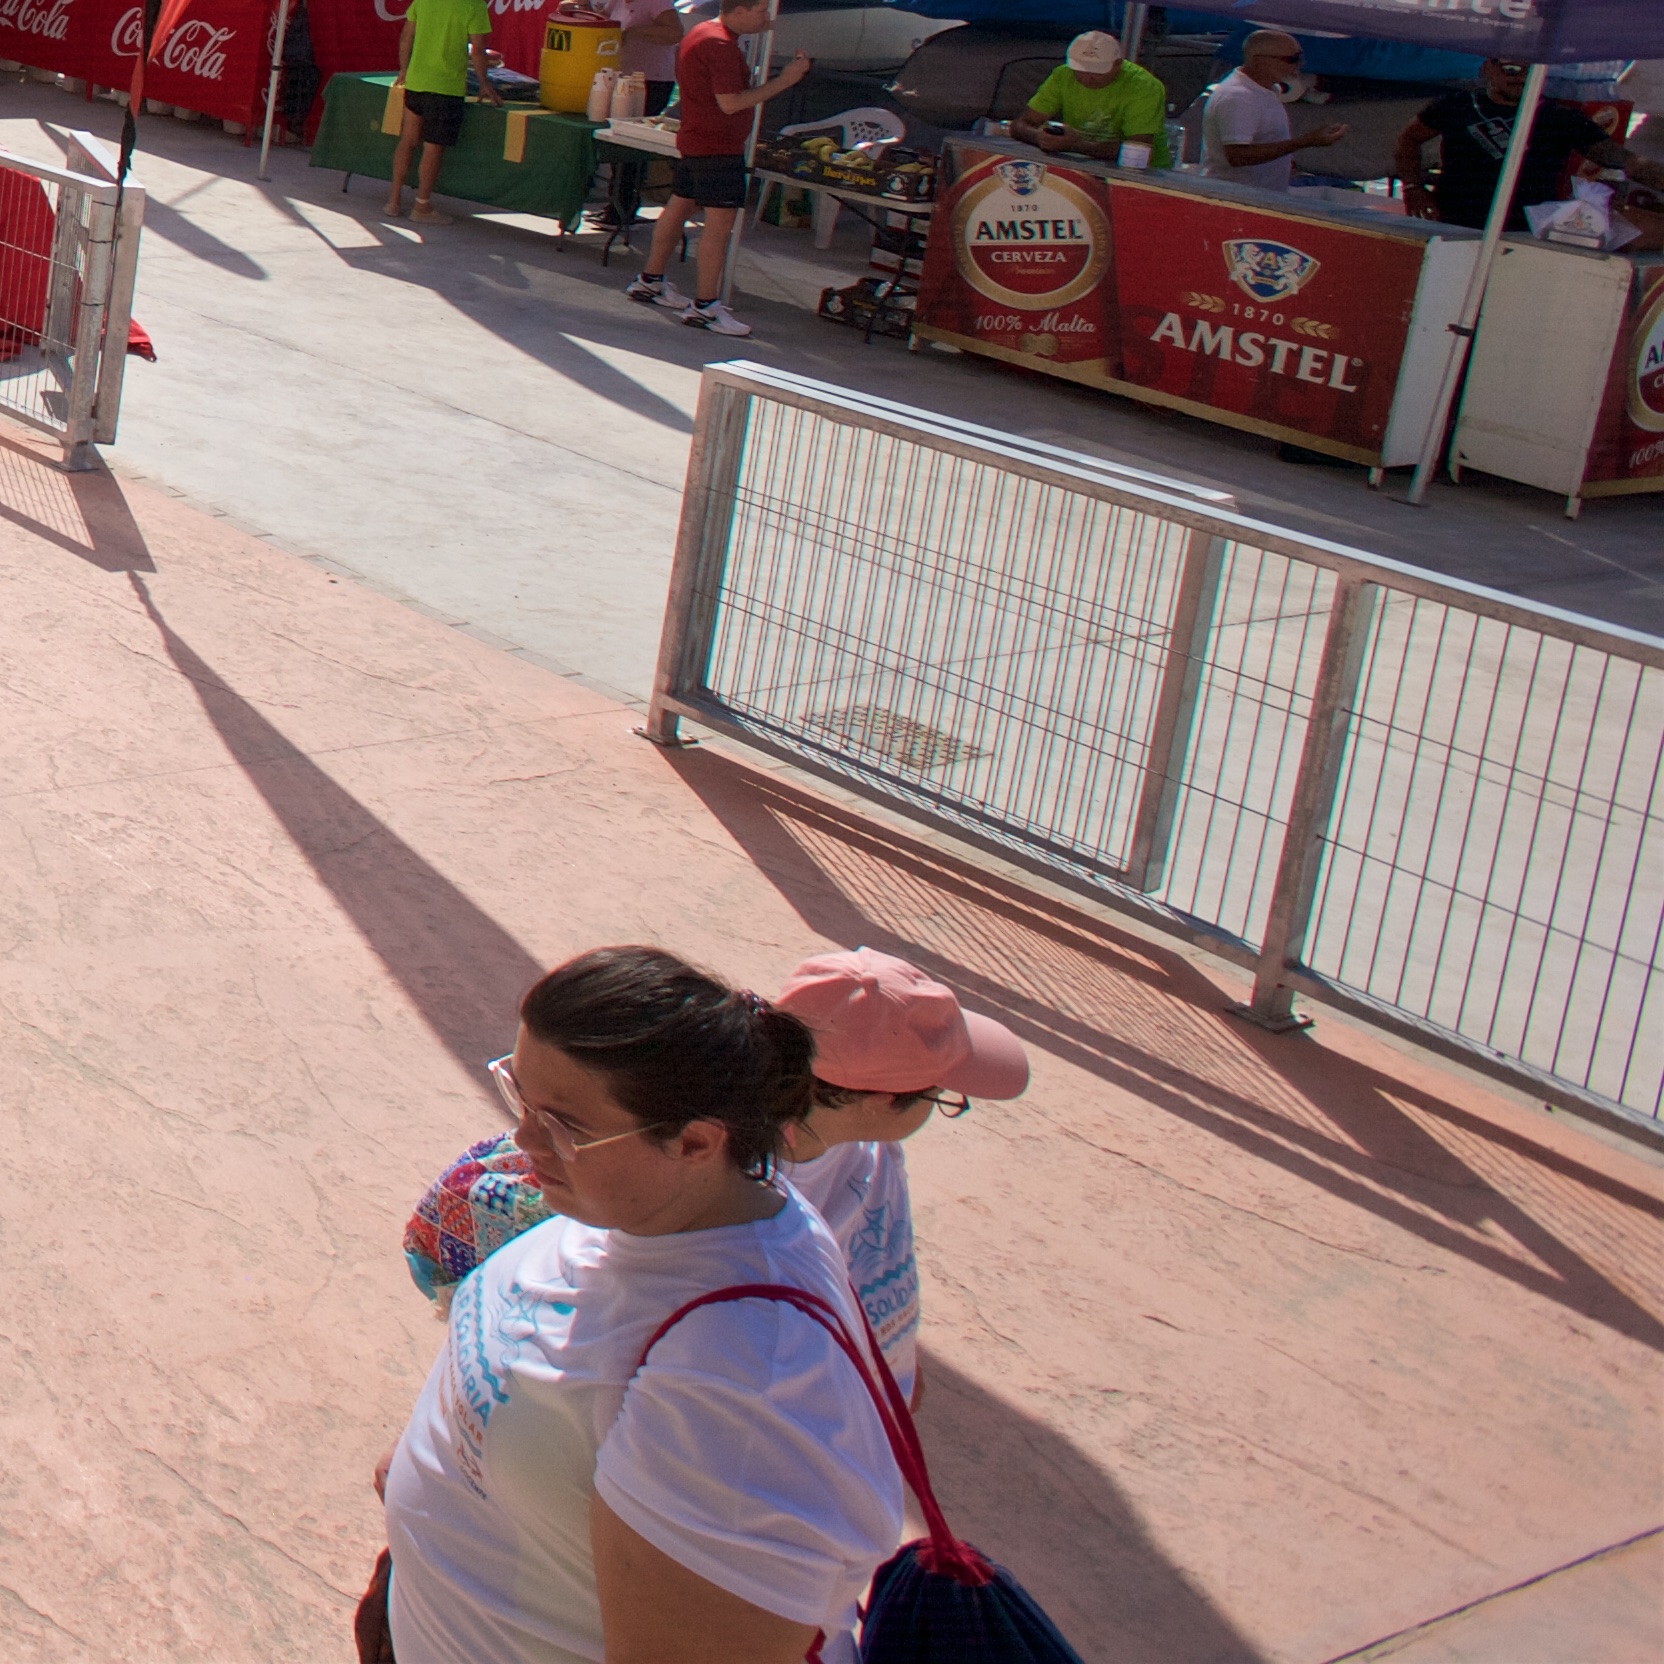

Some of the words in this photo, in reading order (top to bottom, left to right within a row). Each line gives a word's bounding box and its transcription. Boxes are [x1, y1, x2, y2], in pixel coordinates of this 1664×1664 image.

[974, 219, 1084, 241] AMSTEL
[990, 250, 1068, 263] CERVEZA
[973, 314, 1022, 331] 100%
[1028, 311, 1097, 334] Malta
[1232, 303, 1285, 326] 1870
[1149, 312, 1358, 393] AMSTEL
